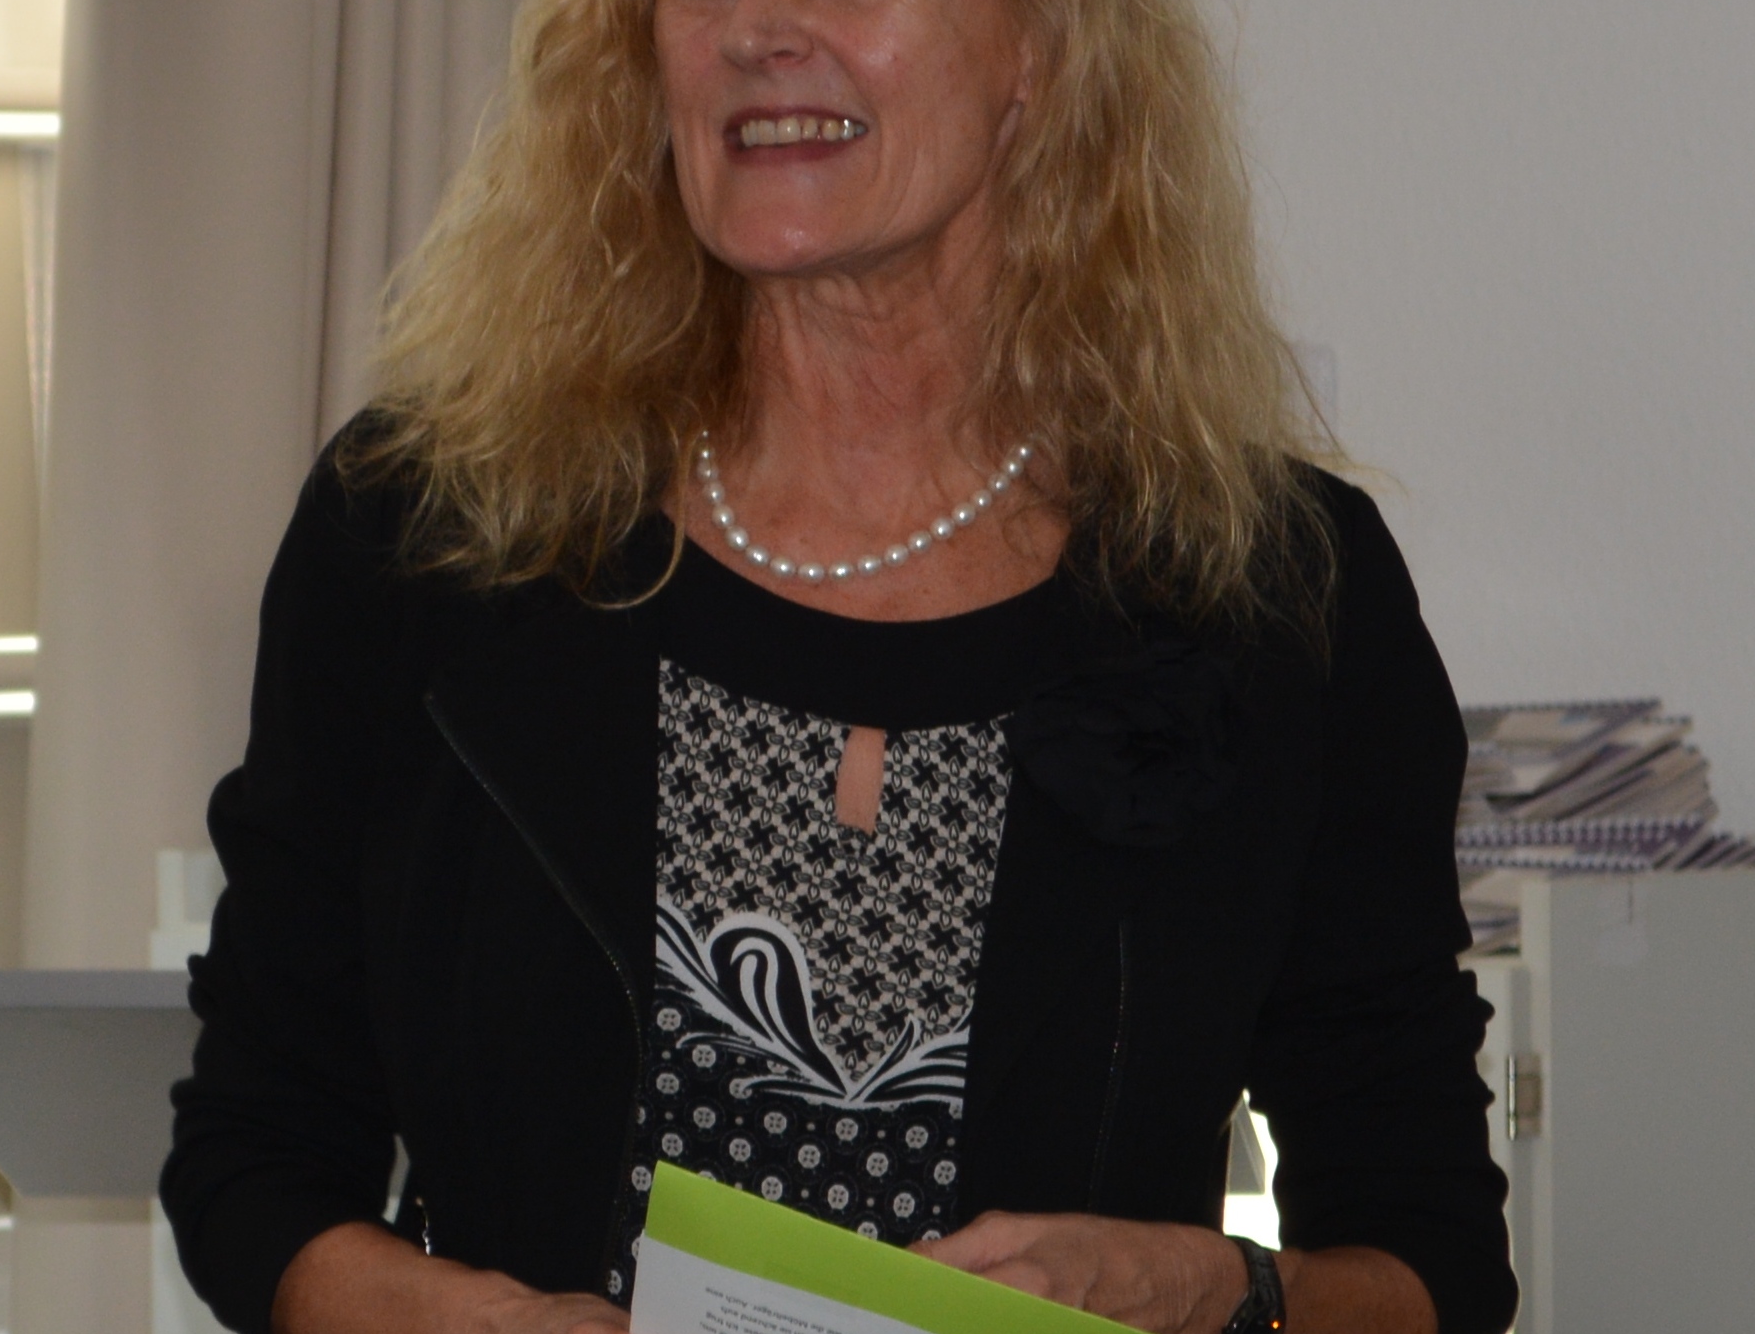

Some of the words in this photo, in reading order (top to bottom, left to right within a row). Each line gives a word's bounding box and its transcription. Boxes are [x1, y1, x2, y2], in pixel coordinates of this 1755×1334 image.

[705, 1287, 724, 1298] eine
[725, 1295, 748, 1308] Auch
[720, 1306, 739, 1317] aufs
[705, 1312, 724, 1326] trug
[740, 1313, 778, 1331] ächzend
